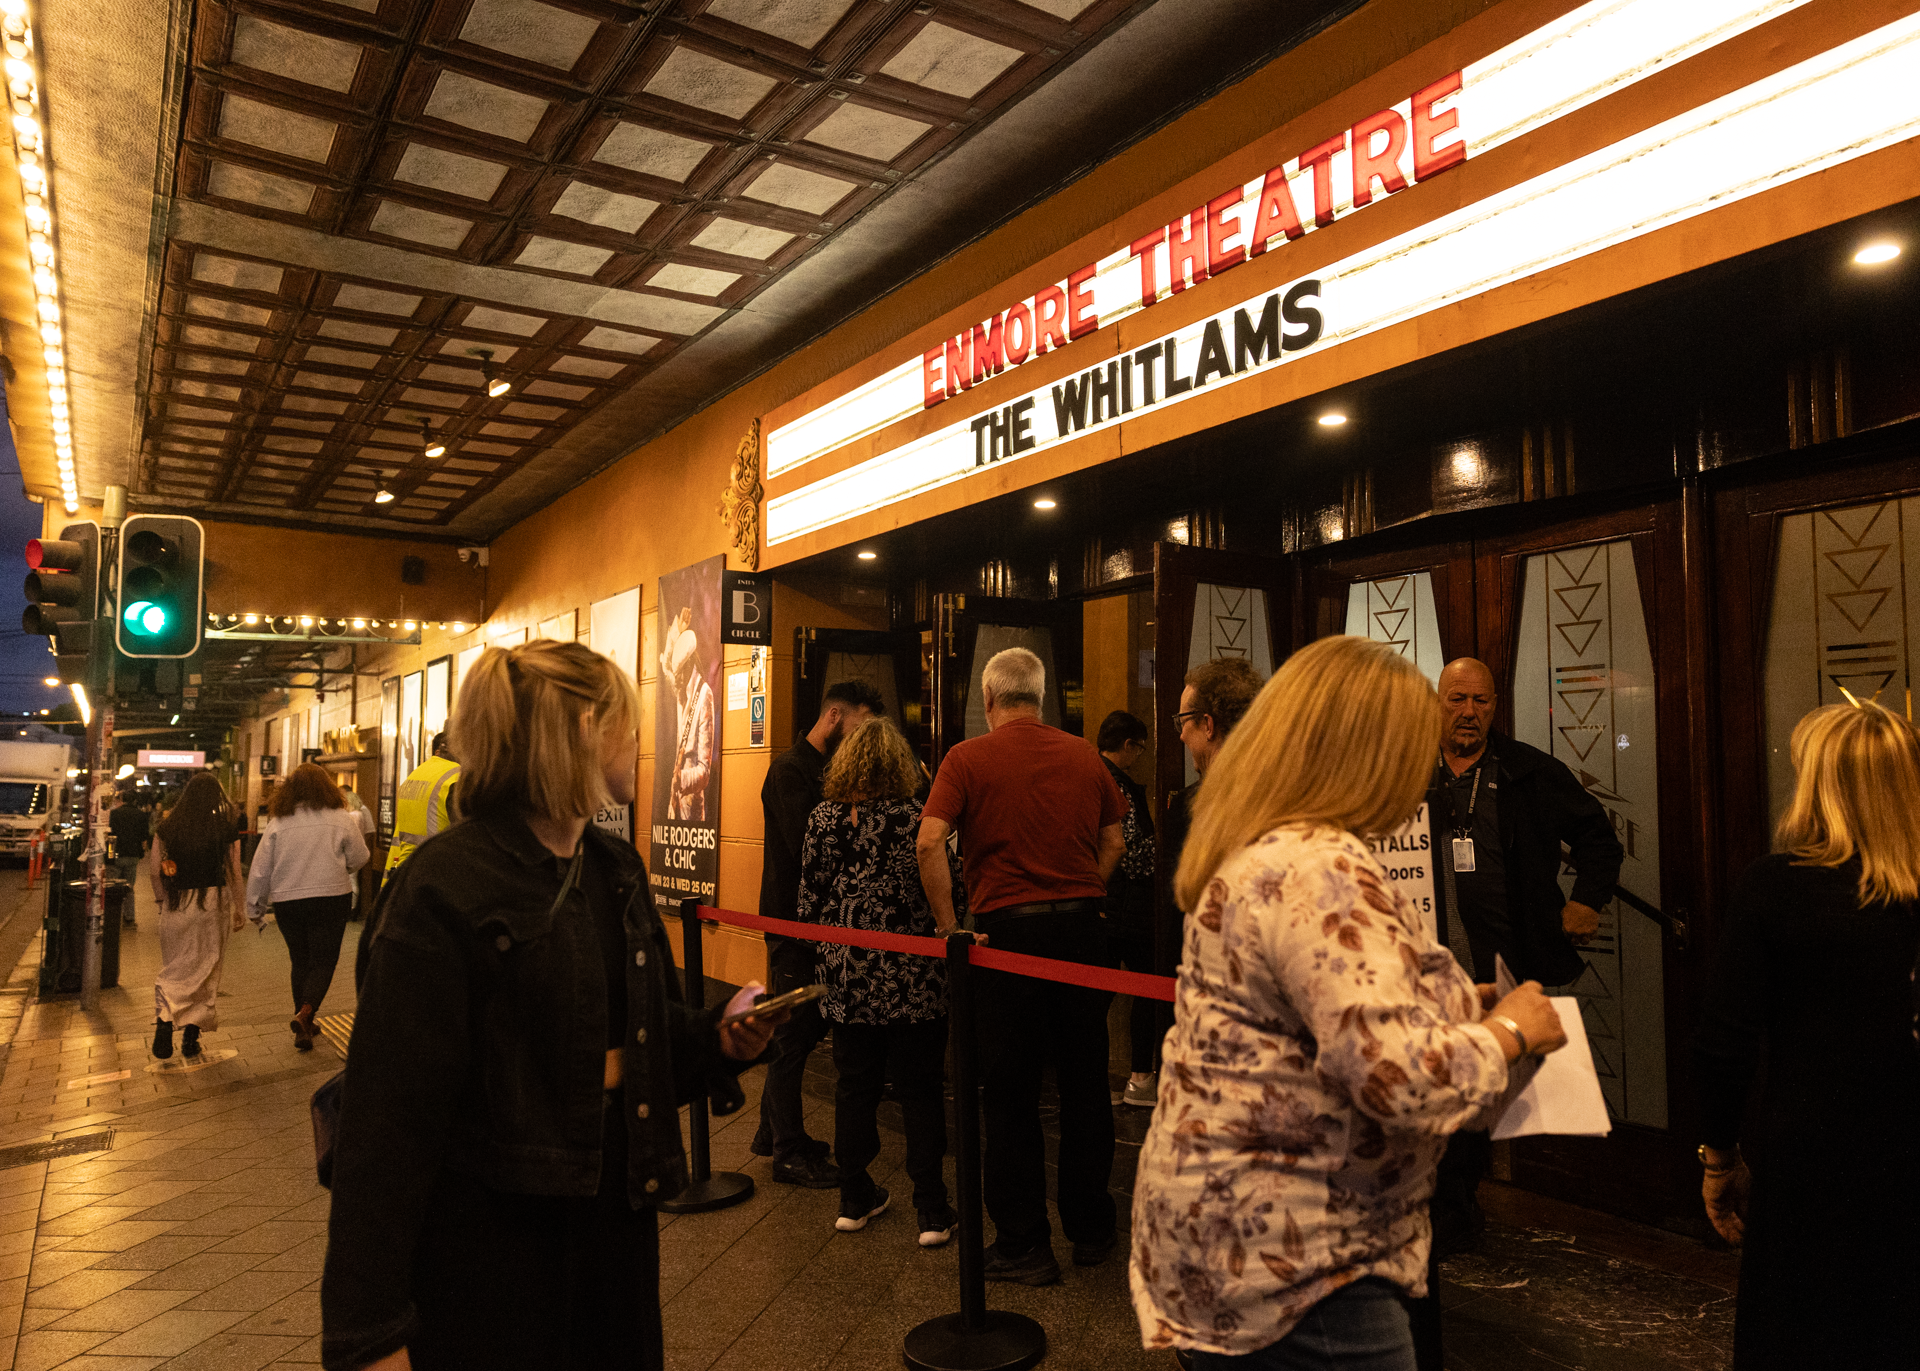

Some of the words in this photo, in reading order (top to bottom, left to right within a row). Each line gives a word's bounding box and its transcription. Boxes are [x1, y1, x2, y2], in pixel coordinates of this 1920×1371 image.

[923, 262, 1099, 410] ENMORE
[1130, 70, 1467, 308] THEATRE
[970, 396, 1036, 467] THE
[1052, 279, 1324, 438] WHITLAMS
[732, 590, 760, 624] B
[731, 629, 761, 638] CIRCLE
[597, 808, 624, 822] EXIT
[652, 825, 668, 844] NILE
[670, 826, 715, 849] RODGERS
[664, 848, 671, 867] &
[673, 849, 696, 870] CHIC
[650, 873, 661, 886] MON
[663, 876, 670, 888] 23
[671, 877, 675, 889] &
[676, 878, 690, 892] WED
[691, 881, 700, 893] 25
[701, 882, 715, 896] OCT
